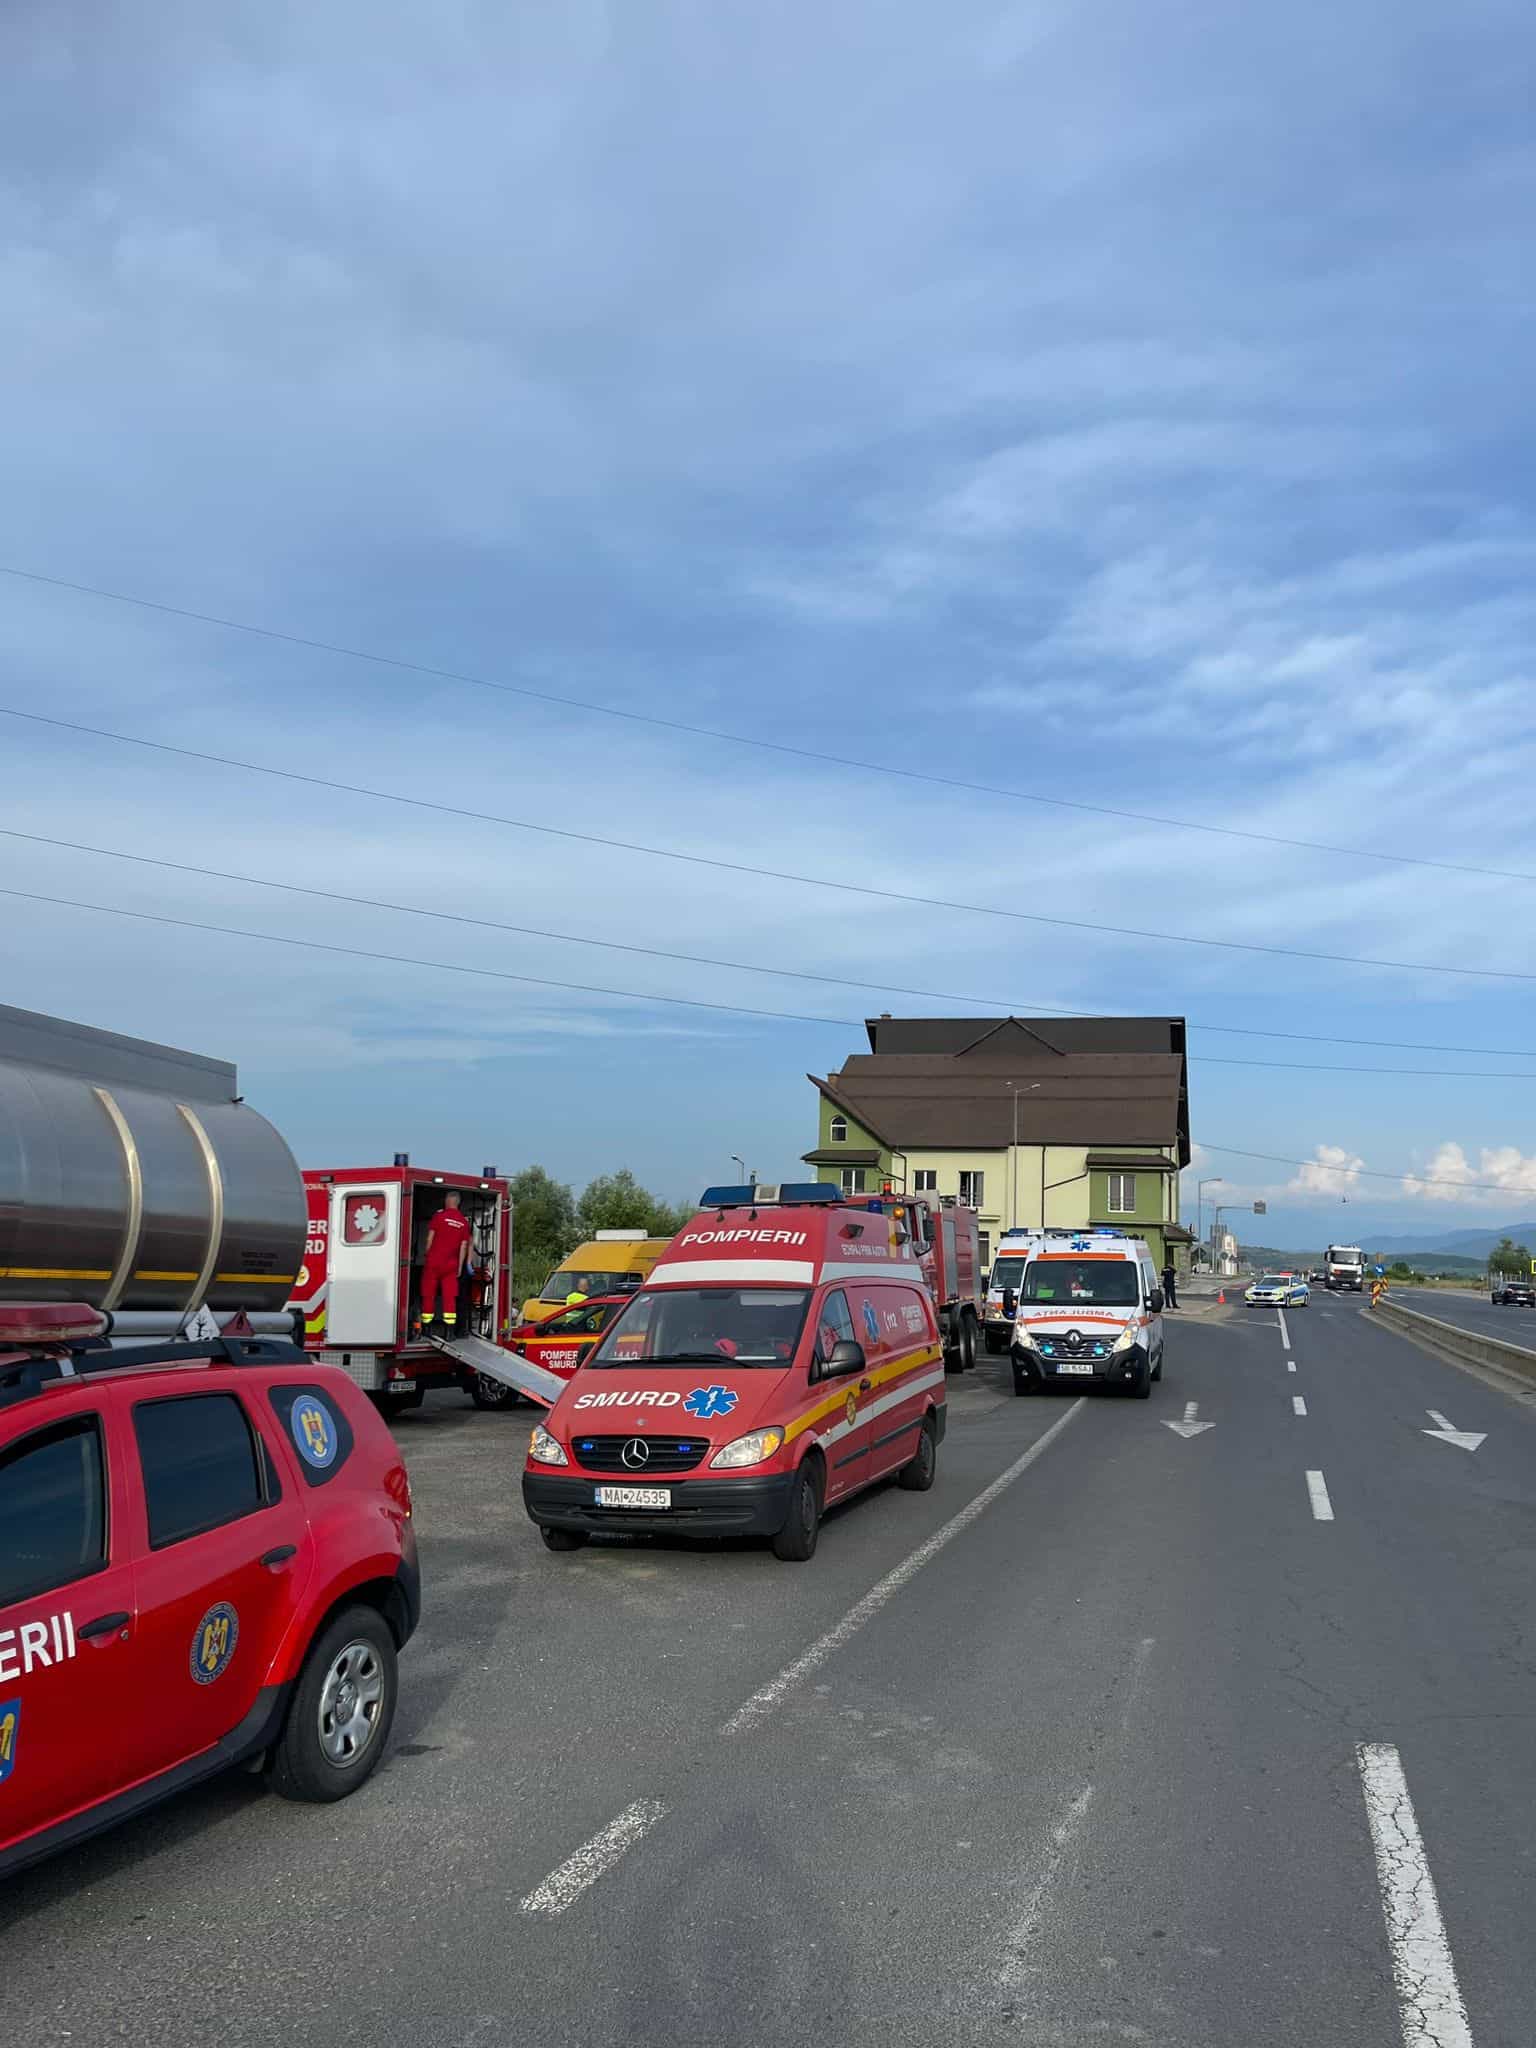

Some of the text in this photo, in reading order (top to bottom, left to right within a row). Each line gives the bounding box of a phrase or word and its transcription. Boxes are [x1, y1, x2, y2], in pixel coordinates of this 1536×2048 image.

[680, 1229, 807, 1247] POMPIERII
[304, 1240, 325, 1254] RD
[548, 1360, 577, 1368] SMURD
[574, 1391, 681, 1409] SMURD
[604, 1489, 666, 1504] MAI 24535
